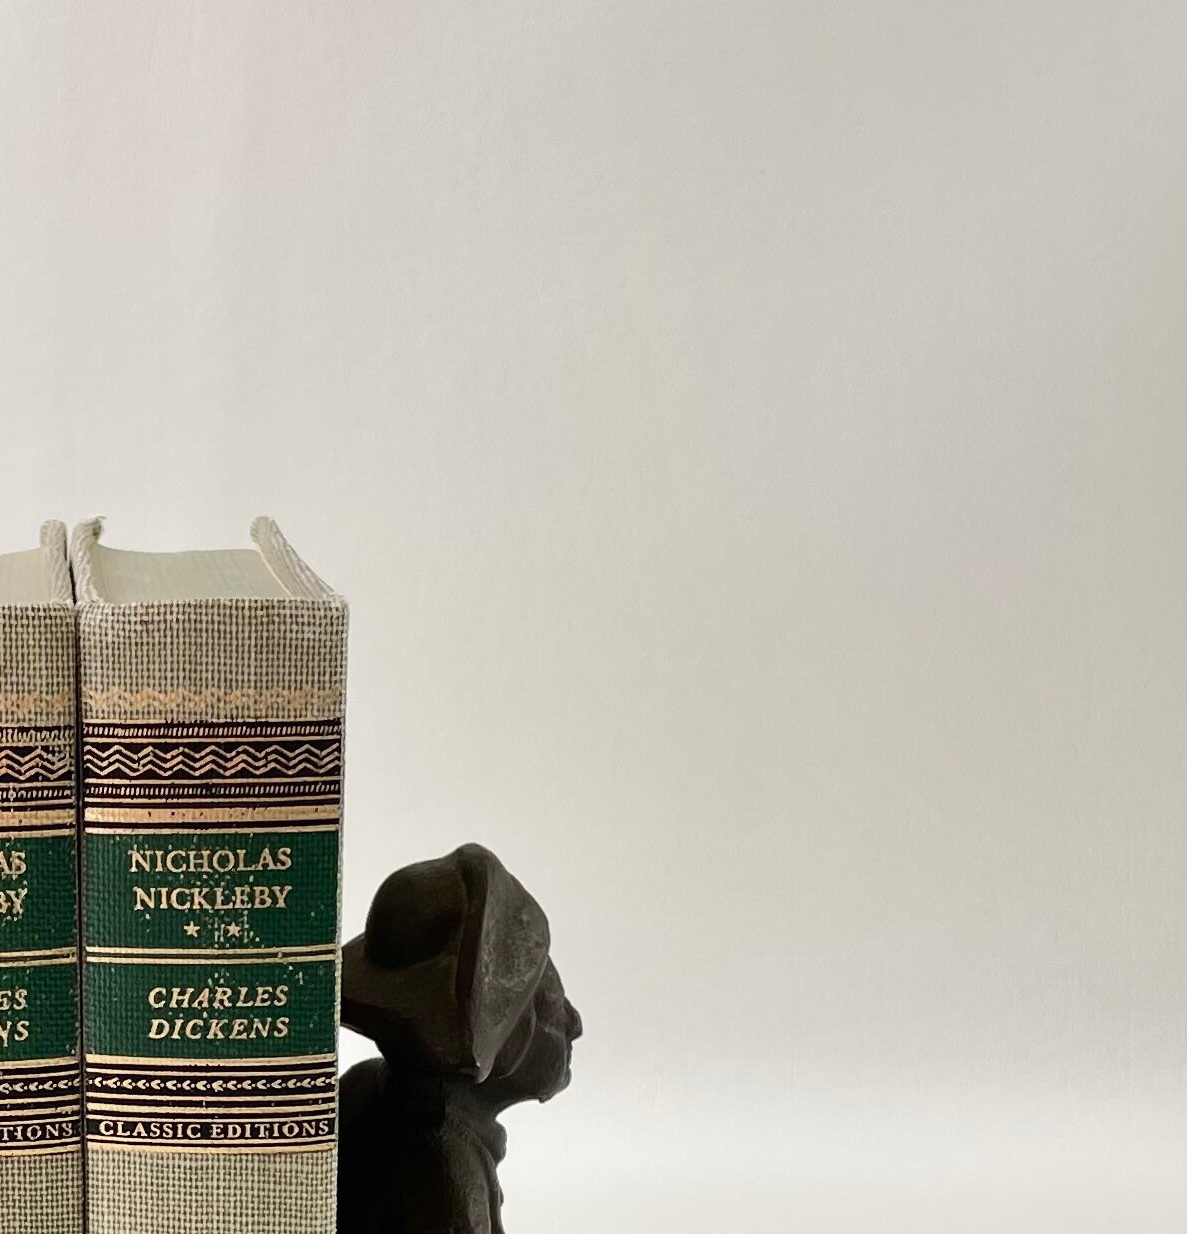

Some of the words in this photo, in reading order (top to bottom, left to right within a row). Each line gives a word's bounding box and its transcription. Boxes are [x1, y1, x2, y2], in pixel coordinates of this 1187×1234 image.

[128, 847, 292, 873] NICHOLAS
[133, 885, 292, 911] NICKLEBY
[147, 985, 289, 1009] CHARLES
[147, 1017, 289, 1040] DICKENS
[99, 1120, 201, 1139] CLASSIC
[210, 1119, 329, 1139] EDITIONS
